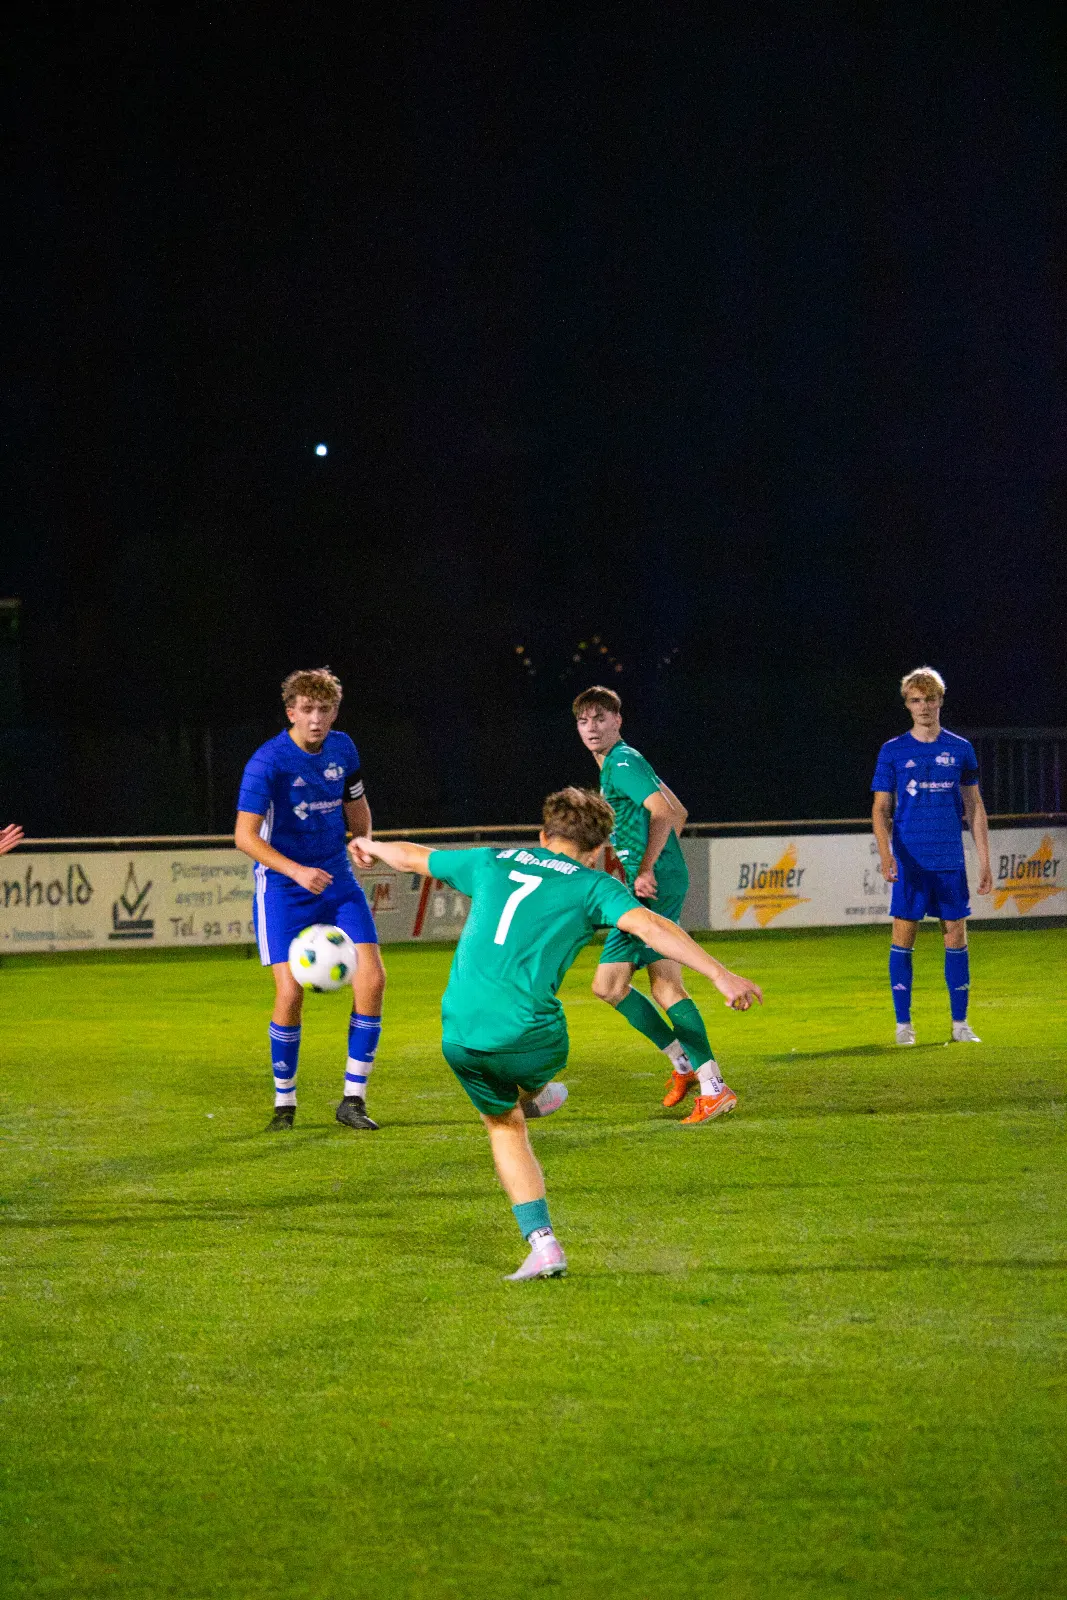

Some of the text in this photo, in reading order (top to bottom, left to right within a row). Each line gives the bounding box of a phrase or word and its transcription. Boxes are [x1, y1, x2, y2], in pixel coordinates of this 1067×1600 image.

[737, 862, 805, 890] Blömer
[997, 853, 1061, 880] Blömer
[1, 863, 94, 908] nhold
[494, 869, 543, 946] 7
